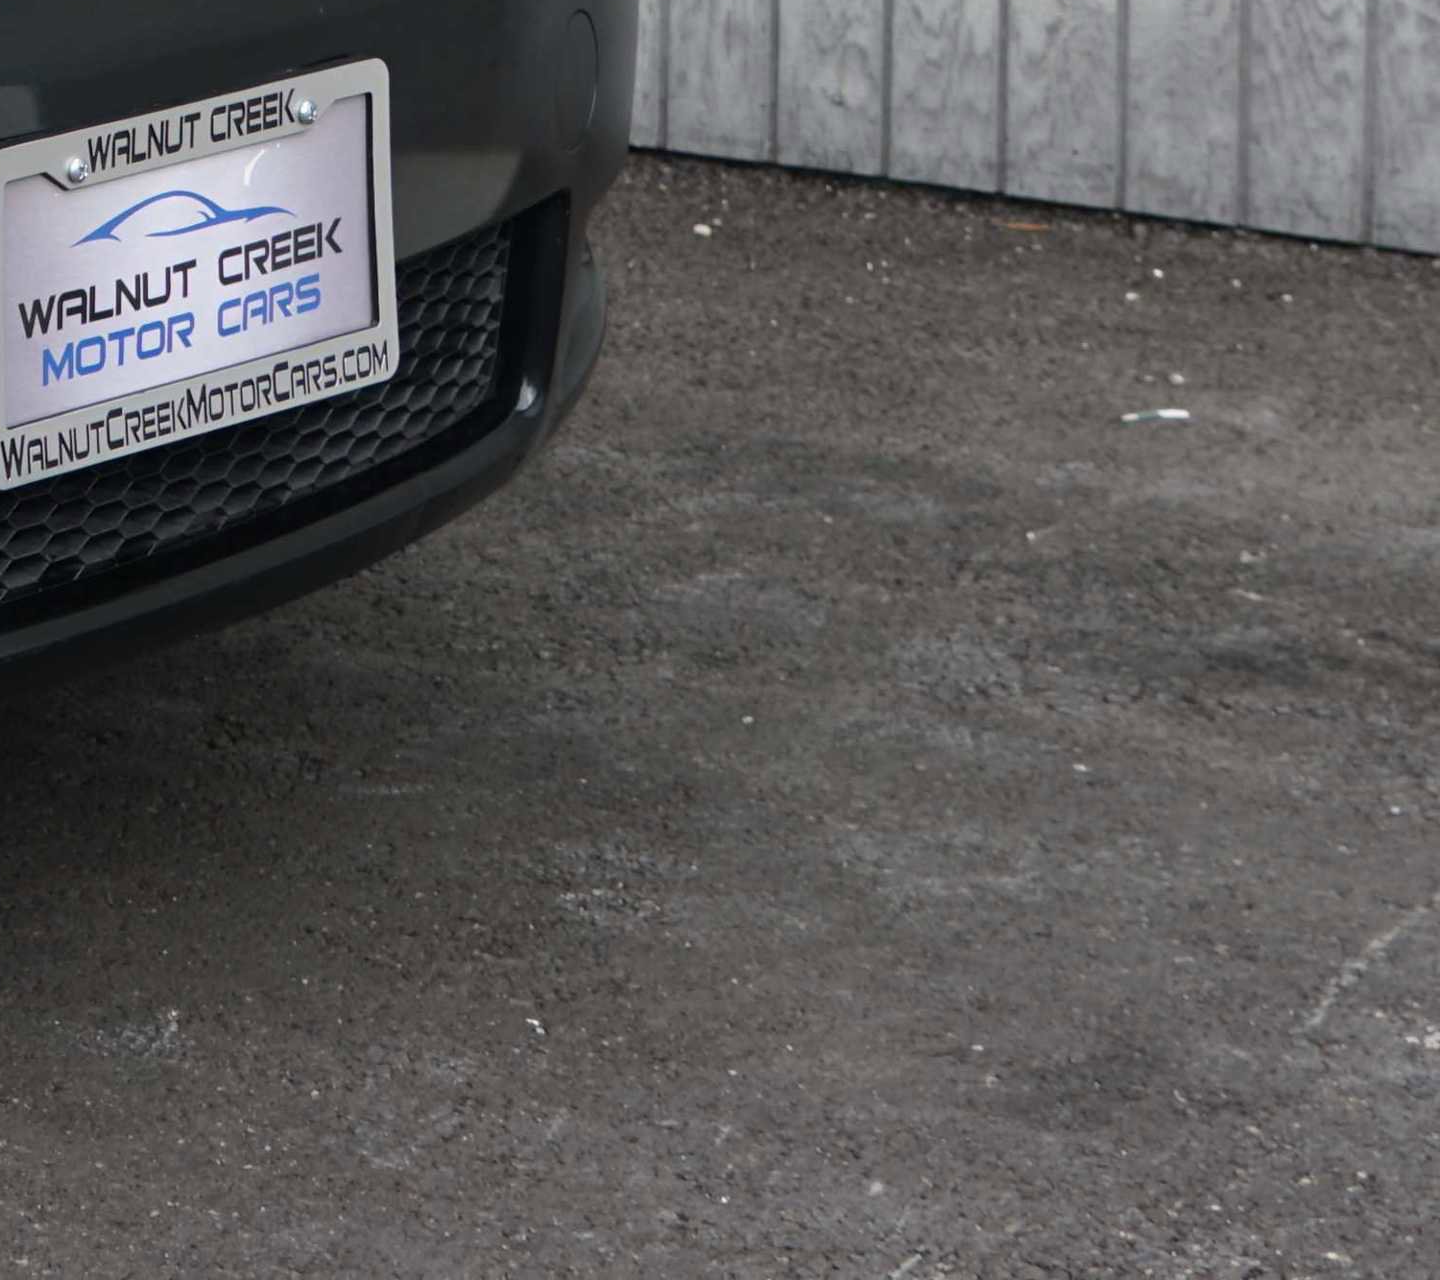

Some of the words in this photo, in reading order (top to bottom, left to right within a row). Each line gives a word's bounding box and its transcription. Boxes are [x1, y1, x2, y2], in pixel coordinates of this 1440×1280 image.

[88, 114, 201, 173] WALNUT
[210, 87, 295, 142] CREEK
[18, 259, 197, 339] WALNUT
[218, 217, 343, 286] CREEK
[41, 312, 195, 387] MOTOR
[217, 273, 322, 337] CARS
